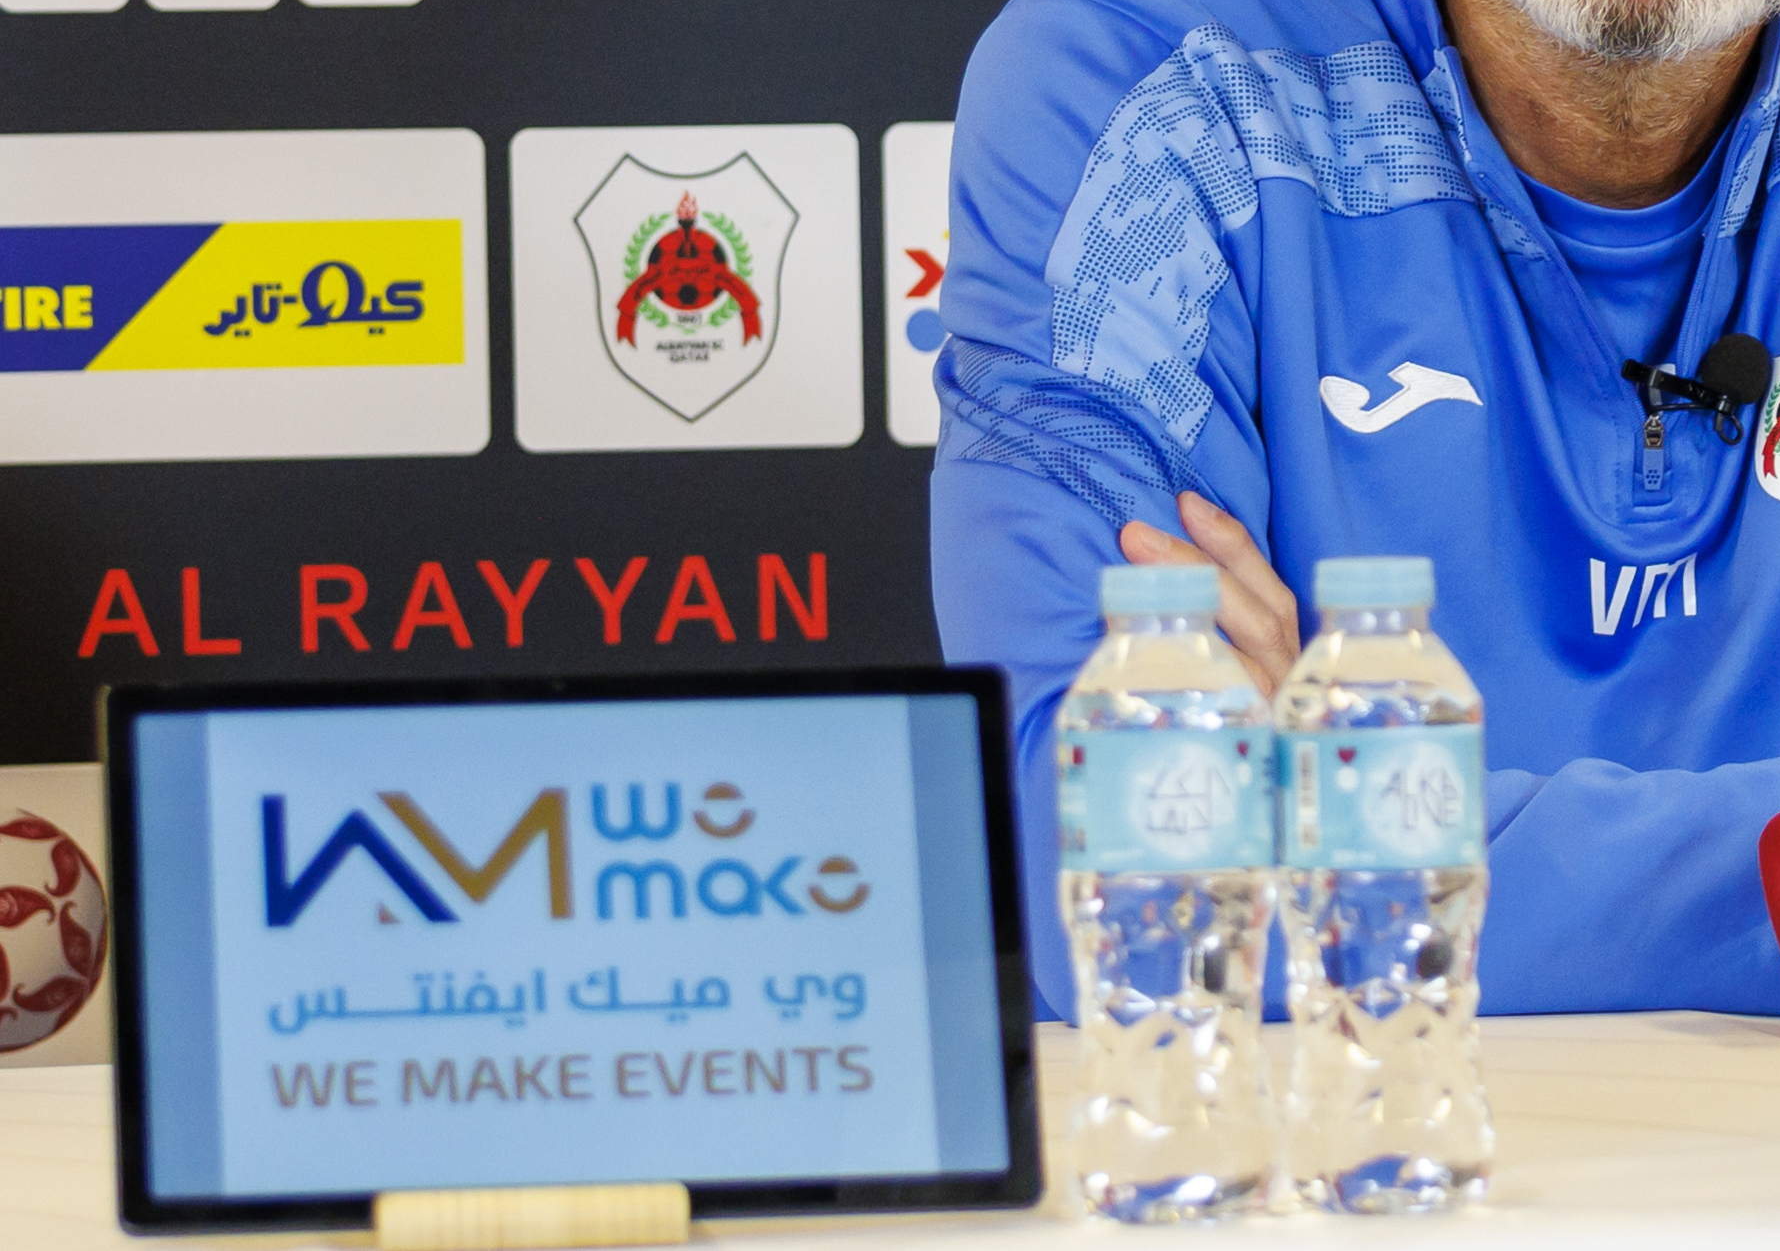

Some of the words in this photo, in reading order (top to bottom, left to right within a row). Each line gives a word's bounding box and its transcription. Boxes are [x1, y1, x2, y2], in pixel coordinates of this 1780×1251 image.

[0, 283, 94, 332] IRE
[79, 567, 241, 657] AL
[300, 553, 827, 652] RAYYAN
[271, 1061, 376, 1109] WE
[401, 1055, 591, 1105] MAKE
[614, 1046, 872, 1099] EVENTS
